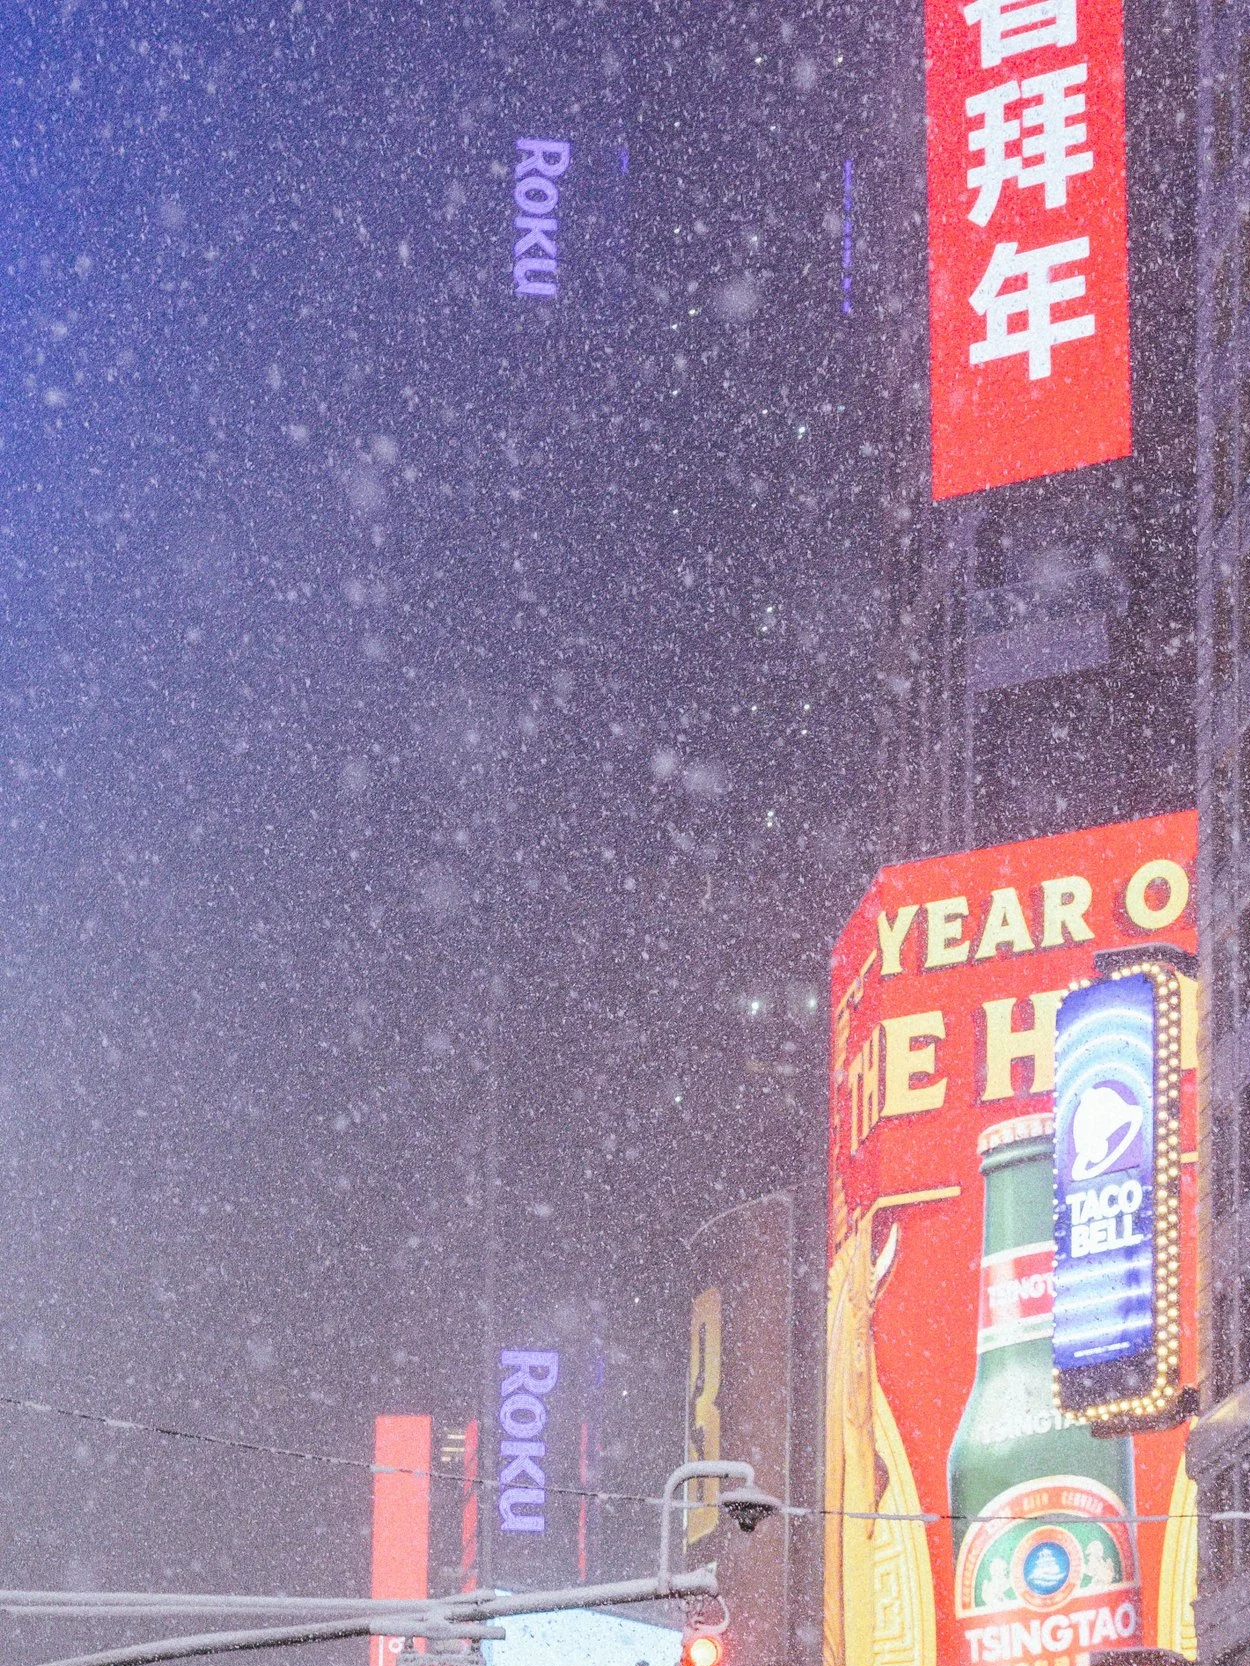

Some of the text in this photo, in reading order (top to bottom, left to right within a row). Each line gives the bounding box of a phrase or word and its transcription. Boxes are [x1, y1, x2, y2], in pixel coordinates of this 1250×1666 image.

[514, 137, 570, 296] ROKU
[877, 873, 1095, 976] YEAR
[1066, 1180, 1143, 1226] TACO
[1071, 1213, 1144, 1259] BELL
[987, 1271, 1054, 1308] TSINGT
[500, 1350, 559, 1532] ROKU
[964, 1601, 1137, 1663] TSINGTAO
